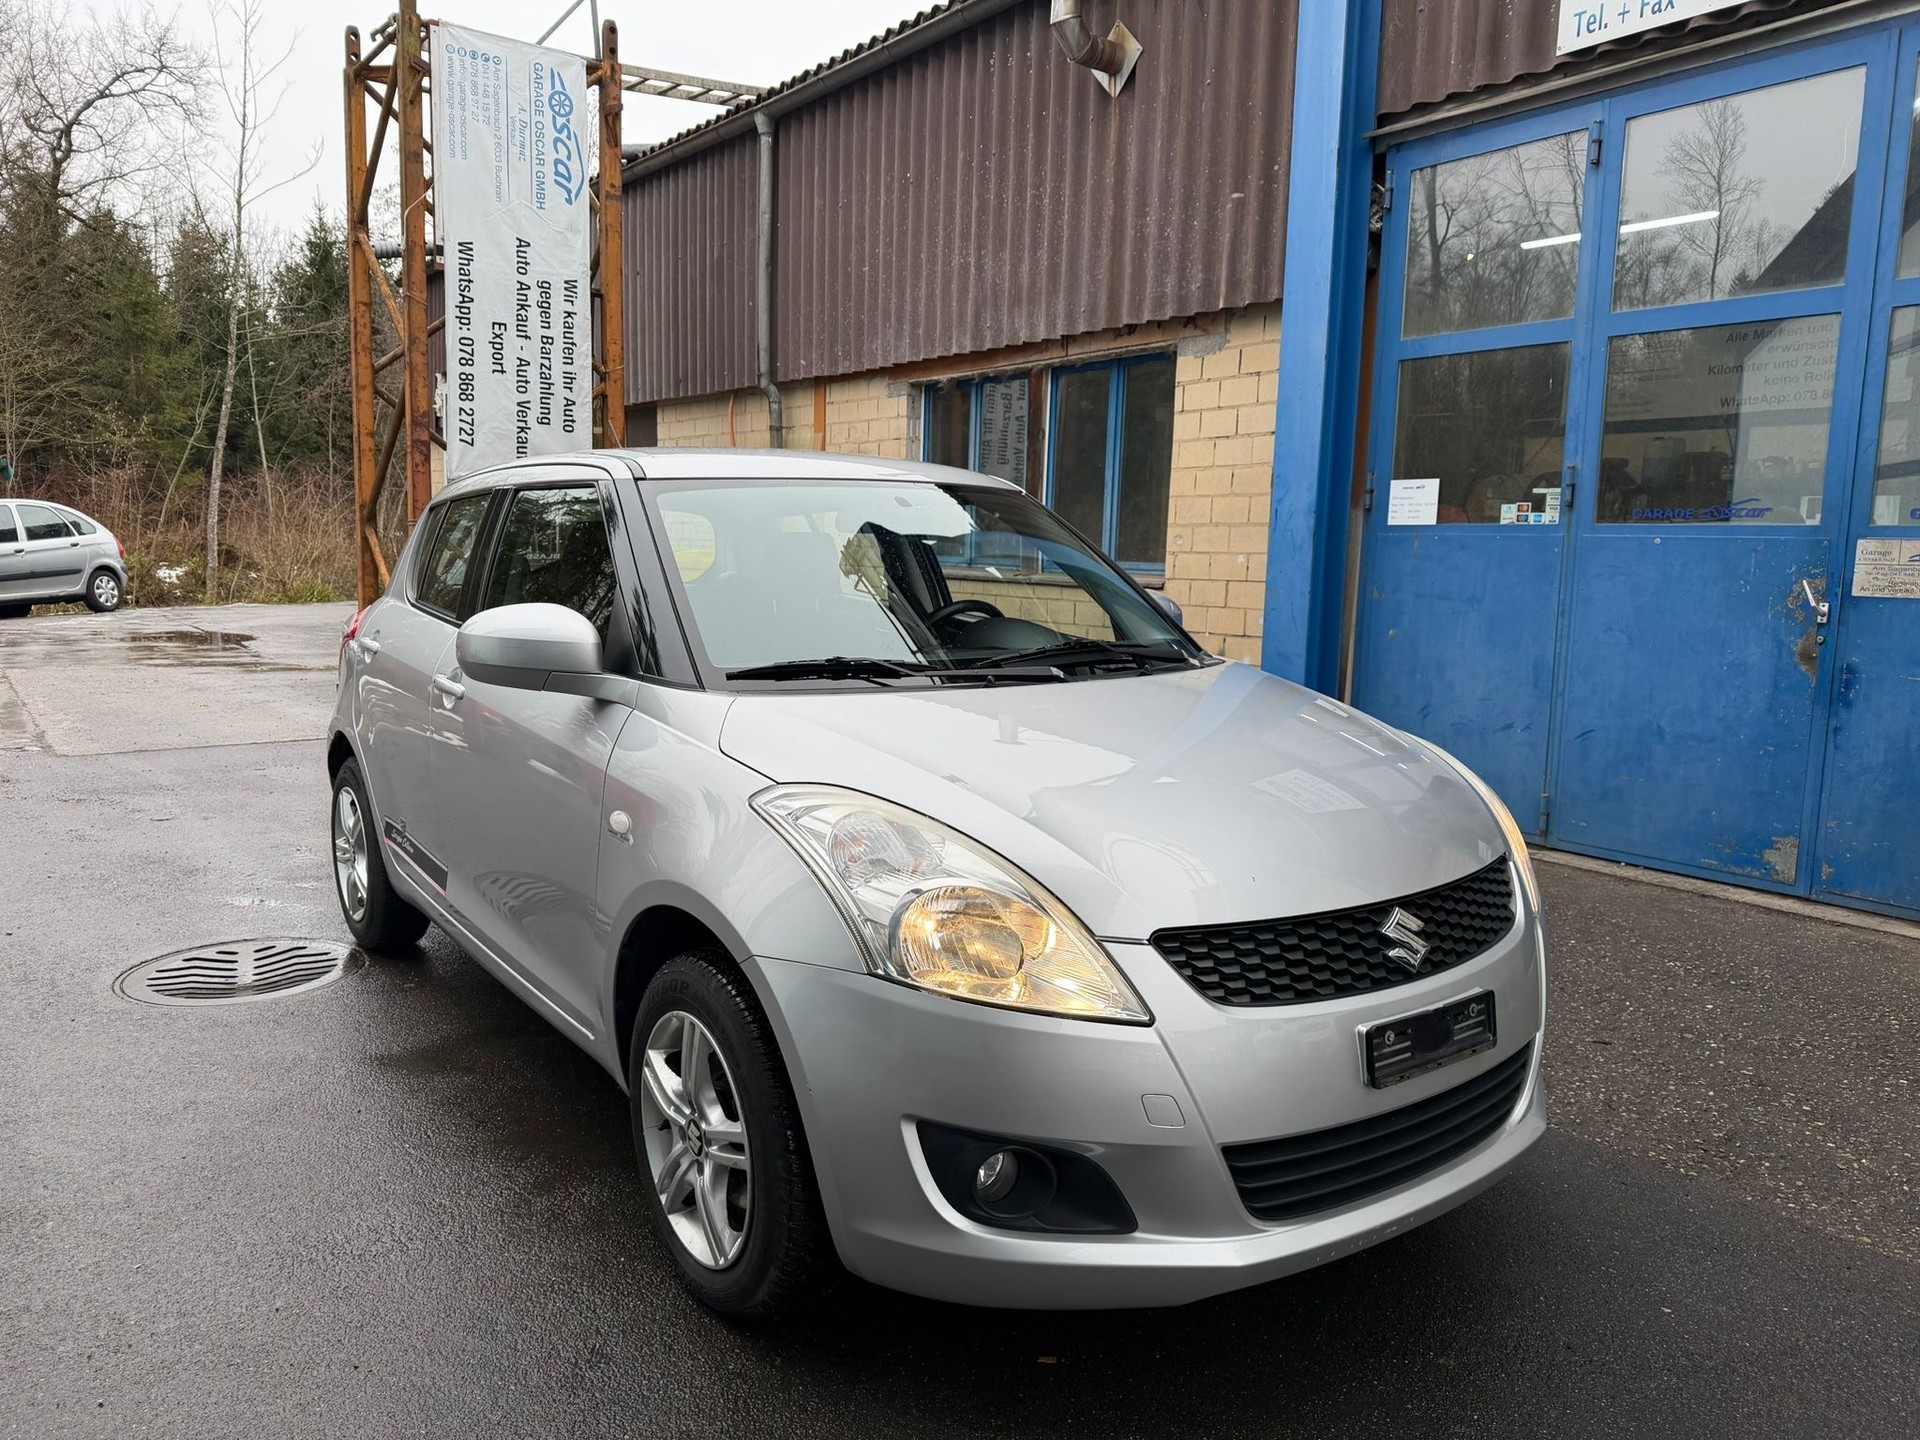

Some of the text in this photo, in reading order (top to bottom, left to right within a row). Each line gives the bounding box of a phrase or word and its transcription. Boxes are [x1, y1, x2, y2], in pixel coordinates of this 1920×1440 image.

[1573, 0, 1676, 38] Tel. + Fax
[469, 61, 480, 123] 078 868 27 27
[481, 64, 491, 126] 041 448 15 72
[492, 66, 501, 82] Am
[446, 55, 456, 158] www.garage-oscar.com
[458, 58, 468, 160] info@garage-oscar.com
[494, 142, 502, 161] 6033
[518, 118, 529, 162] Durmaz
[533, 62, 546, 210] GARAGE OSCAR GMBH
[494, 162, 503, 203] Buchrain
[515, 237, 532, 276] Auto
[515, 280, 532, 341] Ankauf
[455, 240, 475, 448] WhatsApp: 078 868 2727
[488, 321, 508, 375] Export
[537, 280, 555, 426] gegen Barzahlung
[1725, 322, 1834, 344] Alle Marken und
[516, 356, 532, 395] Auto
[562, 279, 578, 434] Wir kaufen ihr Auto
[1708, 359, 1770, 376] Kilometer
[1774, 355, 1799, 369] und
[1719, 393, 1790, 409] WhatsApp:
[1764, 374, 1800, 386] keine
[516, 399, 532, 459] Verkau
[1632, 507, 1694, 519] GARAGE
[1861, 549, 1892, 557] Garage
